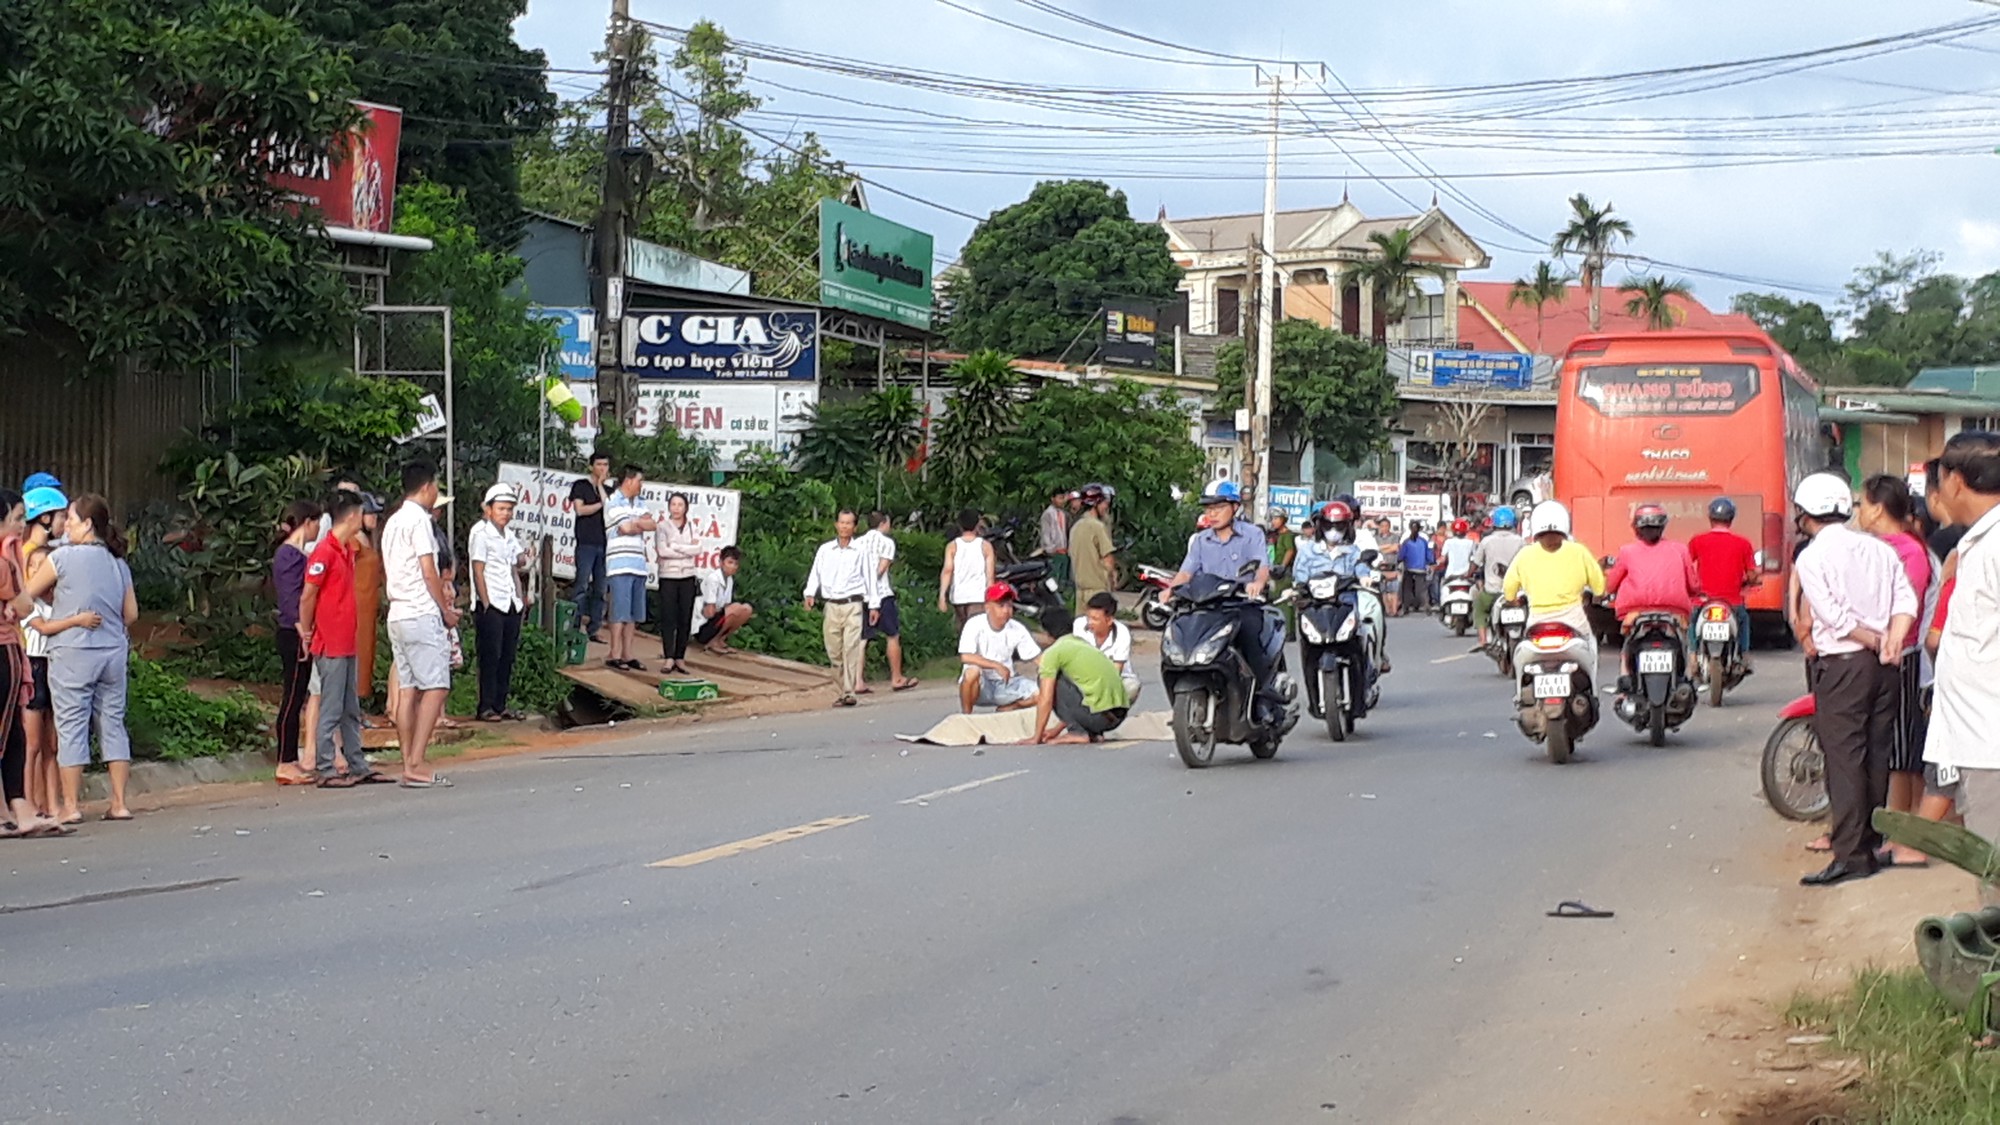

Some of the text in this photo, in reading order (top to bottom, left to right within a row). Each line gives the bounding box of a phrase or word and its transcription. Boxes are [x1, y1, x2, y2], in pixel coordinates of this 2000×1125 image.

[681, 315, 769, 345] GIA
[654, 355, 686, 371] tạo
[690, 353, 726, 372] học
[730, 353, 774, 368] viên
[758, 419, 769, 431] 02
[706, 493, 726, 511] VỤ
[550, 512, 573, 530] BẢO
